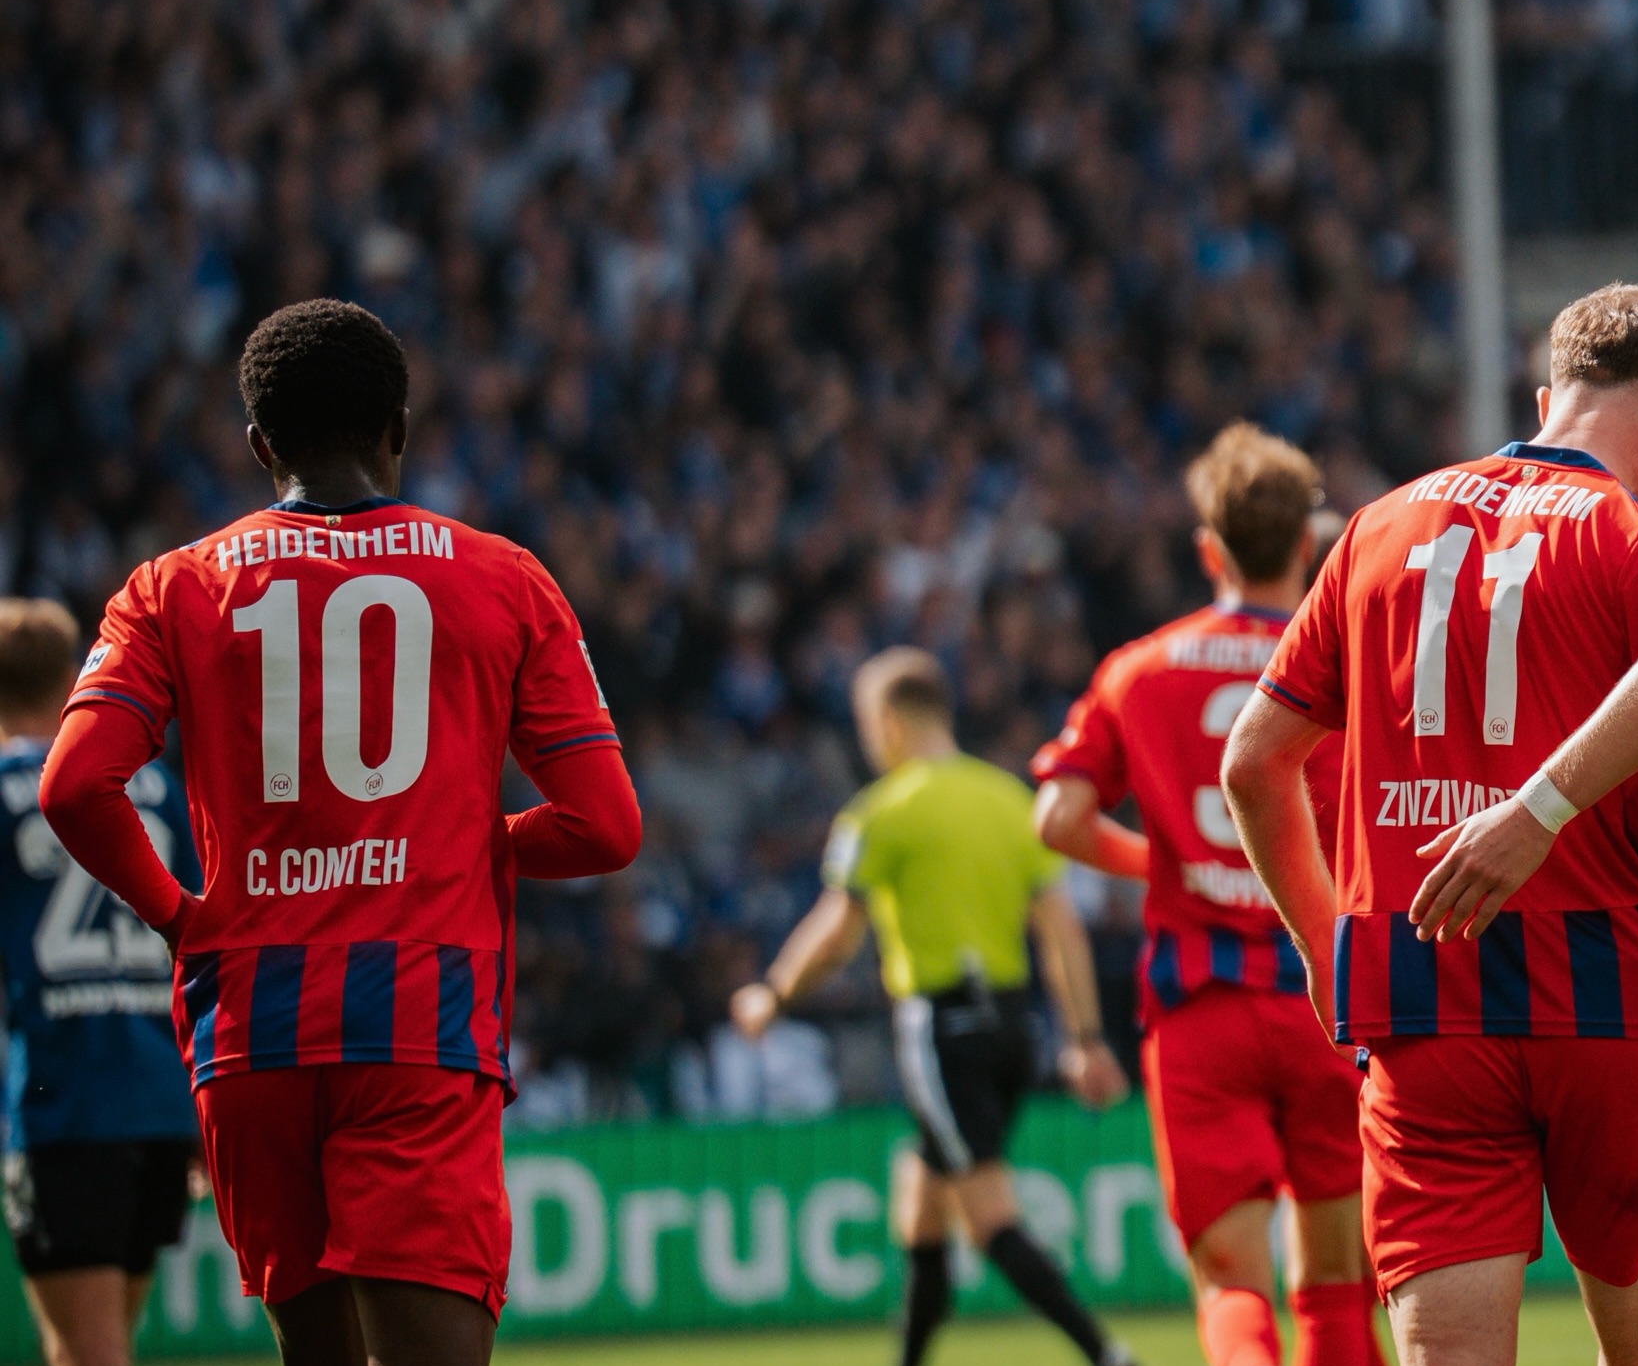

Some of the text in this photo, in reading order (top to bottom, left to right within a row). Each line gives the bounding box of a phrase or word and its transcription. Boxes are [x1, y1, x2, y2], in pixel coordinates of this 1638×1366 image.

[1407, 471, 1605, 521] HEIDENHEIM
[217, 521, 454, 572] HEIDENHEIM
[1405, 524, 1543, 746] 11
[233, 575, 433, 803] 10
[1376, 779, 1518, 826] ZIVZIVA
[247, 838, 407, 896] C.CONTEH
